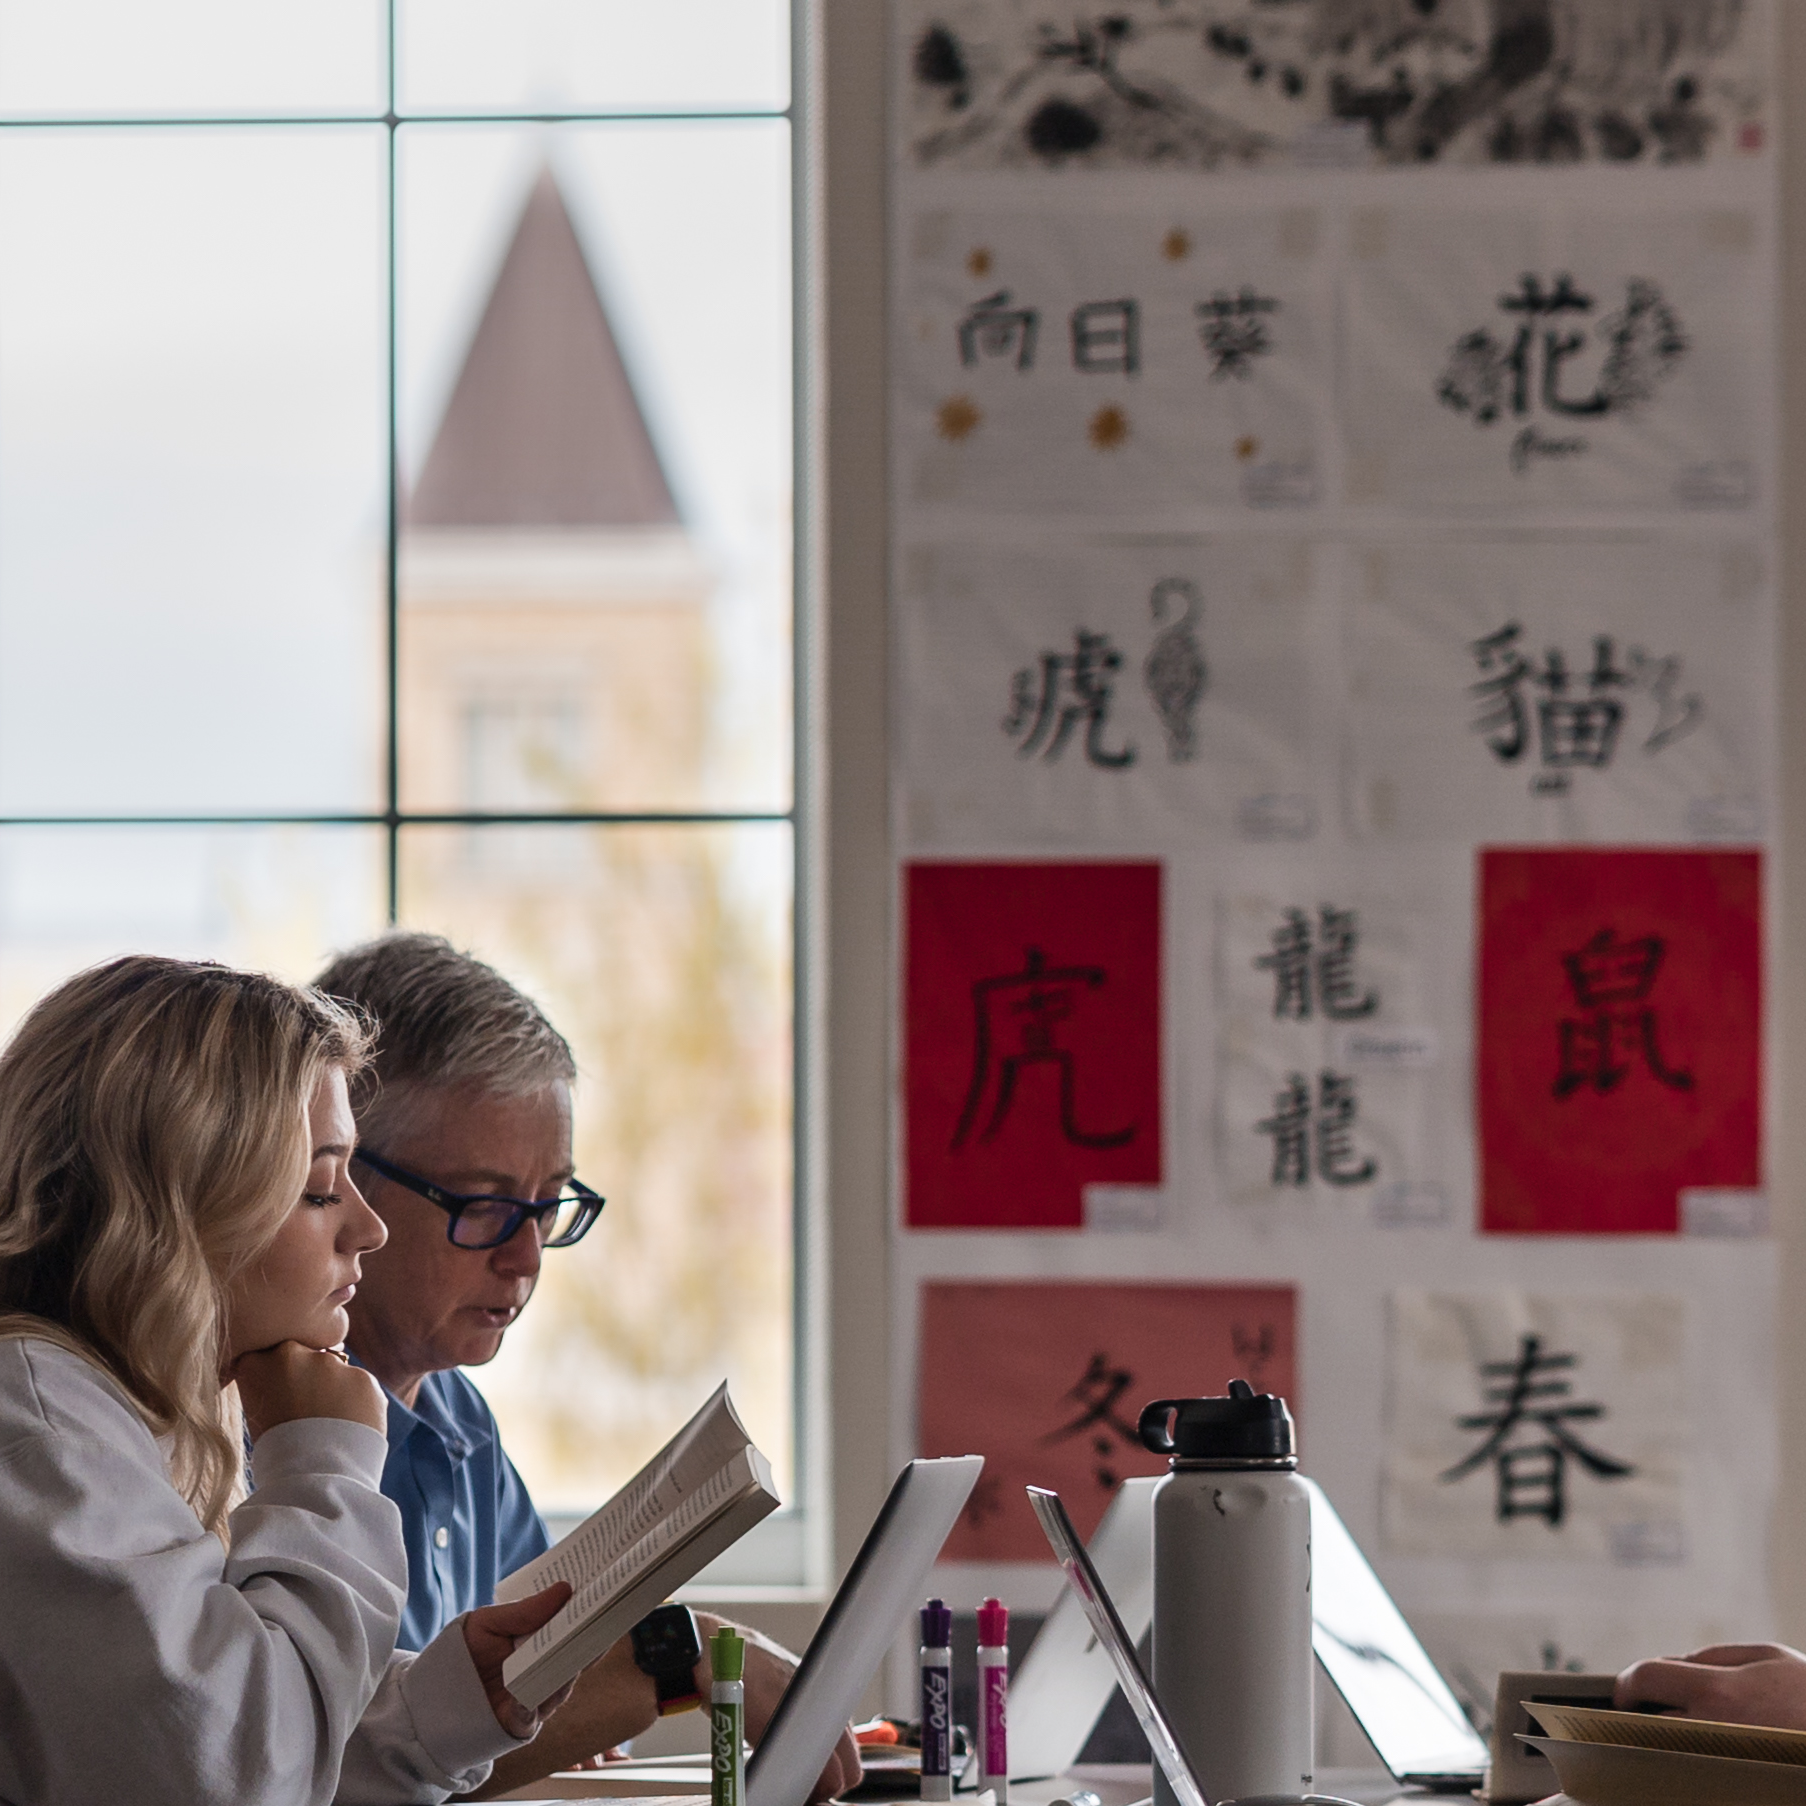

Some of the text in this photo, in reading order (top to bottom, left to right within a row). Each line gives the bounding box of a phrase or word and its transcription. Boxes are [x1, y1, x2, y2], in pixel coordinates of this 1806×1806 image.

[1497, 272, 1610, 415] 花
[1466, 621, 1629, 767] 貓
[1254, 903, 1379, 1022] 龍
[1552, 927, 1695, 1101] 鼠
[950, 946, 1137, 1154] 虎
[1254, 1068, 1379, 1189] 龍
[1439, 1334, 1633, 1529] 春
[712, 1709, 732, 1774] EXPO
[923, 1672, 946, 1730] EXPO
